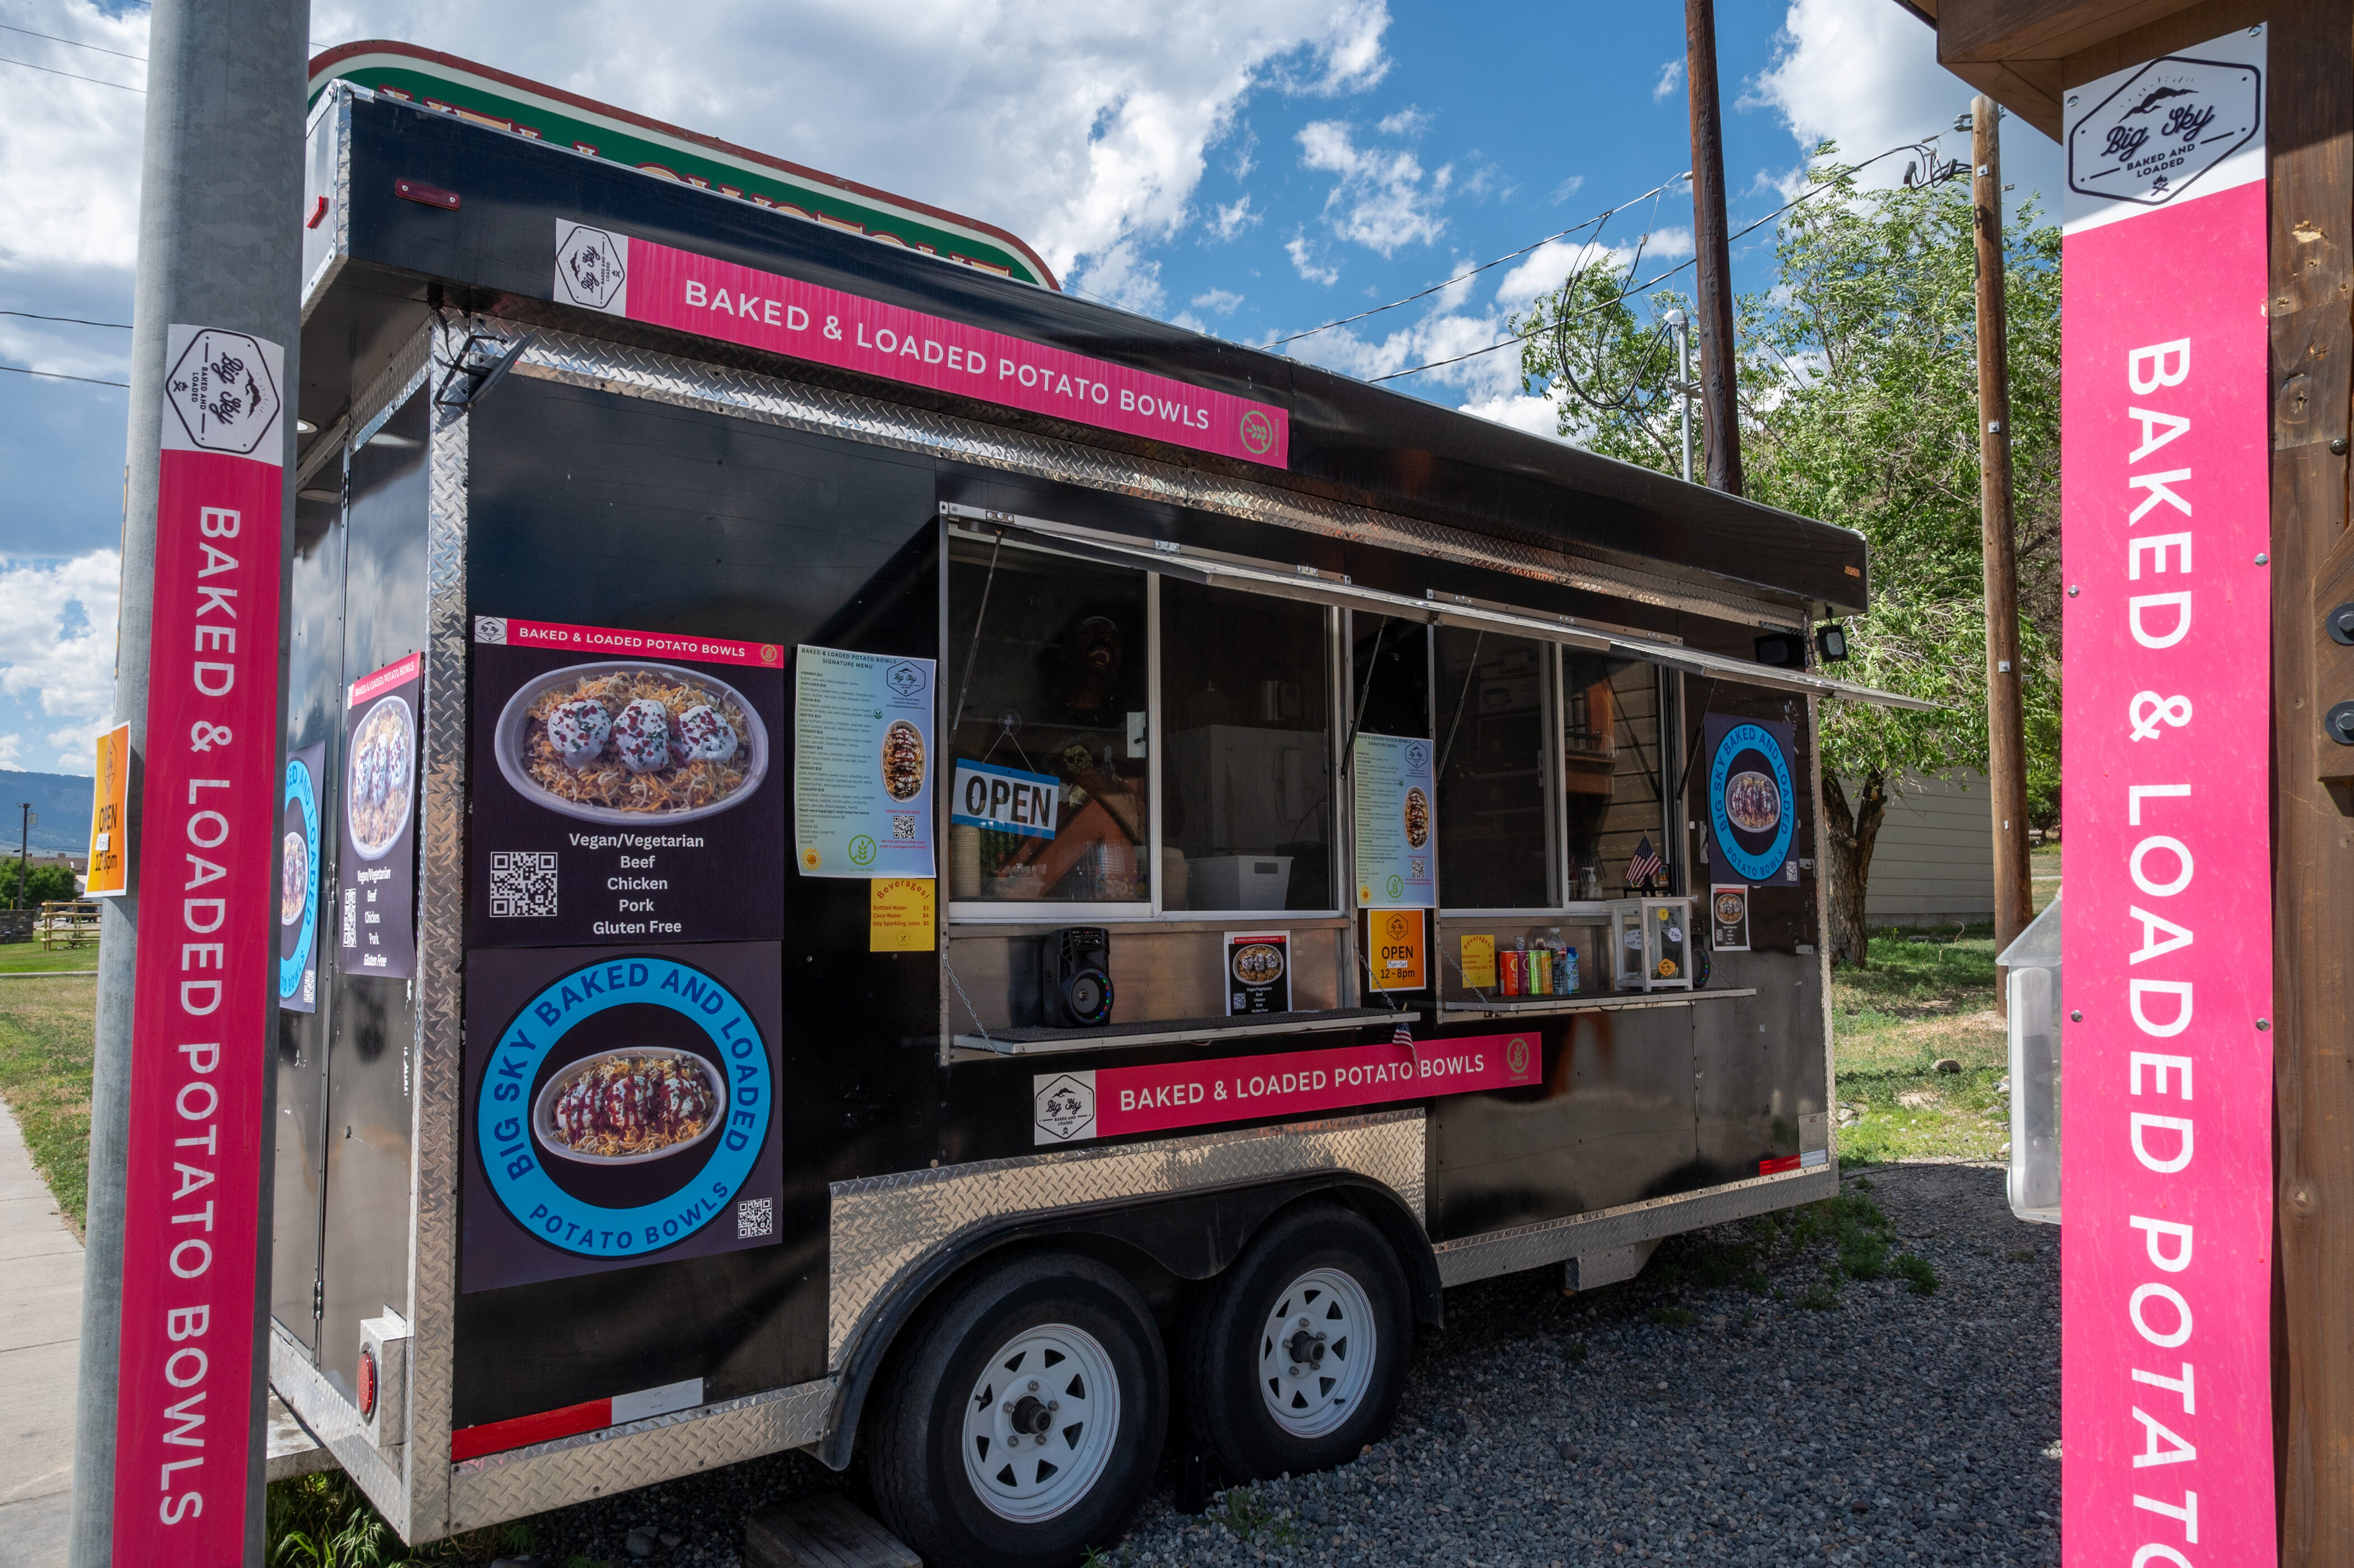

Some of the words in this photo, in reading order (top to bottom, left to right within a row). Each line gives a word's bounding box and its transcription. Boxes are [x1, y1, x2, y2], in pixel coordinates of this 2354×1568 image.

[2101, 125, 2151, 163] Big
[2161, 103, 2217, 142] Sky
[2126, 152, 2166, 171] BAKED
[2169, 143, 2195, 159] AND
[2137, 157, 2185, 178] LOADED
[582, 245, 600, 268] Sky
[581, 272, 600, 293] Big
[211, 351, 244, 384] Big
[686, 280, 809, 331] BAKED
[823, 315, 842, 341] &
[857, 322, 986, 374] LOADED
[999, 358, 1109, 405] POTATO
[1120, 389, 1209, 429] BOWLS
[191, 372, 200, 402] LOADED
[208, 391, 242, 425] Sky
[2128, 337, 2192, 649] BAKED
[193, 506, 241, 697] BAKED
[520, 627, 568, 641] BAKED
[572, 632, 581, 642] &
[586, 633, 642, 647] LOADED
[647, 639, 698, 652] POTATO
[702, 644, 745, 657] BOWLS
[822, 658, 855, 667] SIGNATURE
[355, 684, 367, 697] BAKED
[369, 675, 384, 690] LOADED
[384, 669, 399, 683] POTATO
[400, 661, 414, 676] BOWLS
[2129, 690, 2193, 743] &
[190, 720, 233, 753] &
[1723, 728, 1755, 755] BAKED
[1759, 733, 1778, 760] AND
[1714, 755, 1725, 791] SKY
[965, 774, 1052, 828] OPEN
[1776, 763, 1790, 834] LOADED
[99, 802, 118, 833] OPEN
[1715, 799, 1727, 833] BIG
[299, 768, 311, 806] AND
[305, 809, 317, 926] LOADED
[569, 833, 704, 848] Vegan/Vegetarian
[357, 866, 391, 885] Vegan/Vegetarian
[620, 855, 655, 869] Beef
[1727, 846, 1757, 876] POTATO
[1761, 848, 1784, 876] BOWLS
[180, 779, 231, 1016] LOADED
[367, 889, 377, 902] Beef
[607, 877, 668, 890] Chicken
[877, 880, 930, 899] Beverages!
[365, 911, 380, 924] Chicken
[619, 899, 654, 912] Pork
[369, 933, 379, 945] Pork
[592, 921, 645, 935] Gluten
[650, 920, 682, 934] Free
[1463, 936, 1493, 950] Beverages!
[364, 953, 377, 967] Gluten
[377, 954, 387, 967] Free
[1382, 945, 1414, 960] OPEN
[289, 950, 305, 992] BOWLS
[1380, 969, 1390, 979] 12
[1397, 968, 1415, 981] 8pm
[2129, 783, 2194, 1173] LOADED
[533, 963, 650, 1028] BAKED
[660, 968, 724, 1015] AND
[494, 1028, 537, 1103] SKY
[721, 1017, 759, 1152] LOADED
[1121, 1083, 1204, 1111] BAKED
[1213, 1080, 1227, 1101] &
[1236, 1070, 1327, 1098] LOADED
[1334, 1061, 1413, 1087] POTATO
[1420, 1054, 1484, 1078] BOWLS
[1046, 1100, 1062, 1117] Big
[1065, 1098, 1082, 1115] Sky
[169, 1042, 220, 1279] POTATO
[494, 1116, 535, 1181] BIG
[529, 1203, 633, 1250] POTATO
[645, 1180, 729, 1245] BOWLS
[159, 1304, 210, 1525] BOWLS
